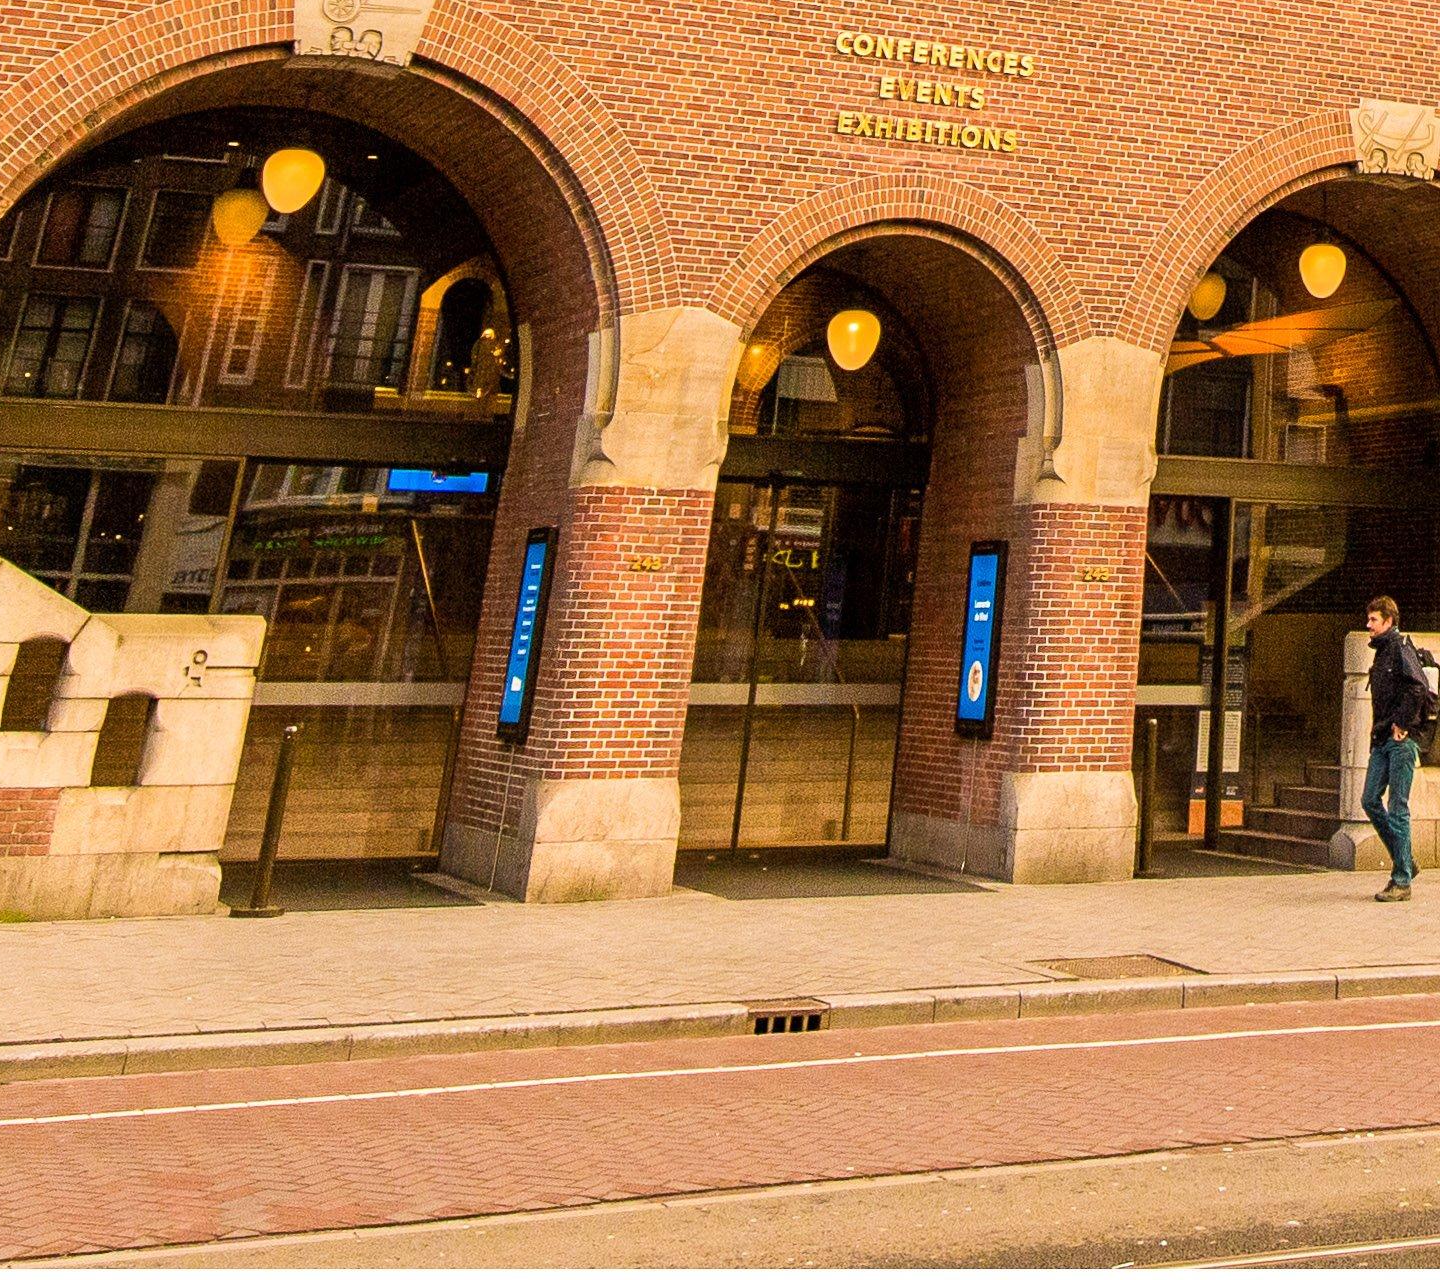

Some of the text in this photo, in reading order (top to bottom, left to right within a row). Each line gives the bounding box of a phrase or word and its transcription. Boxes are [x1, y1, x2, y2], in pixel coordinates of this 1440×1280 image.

[835, 31, 1035, 77] CONFERENCES
[878, 76, 986, 111] EVENTS
[836, 110, 1018, 153] EXHIBITIONS
